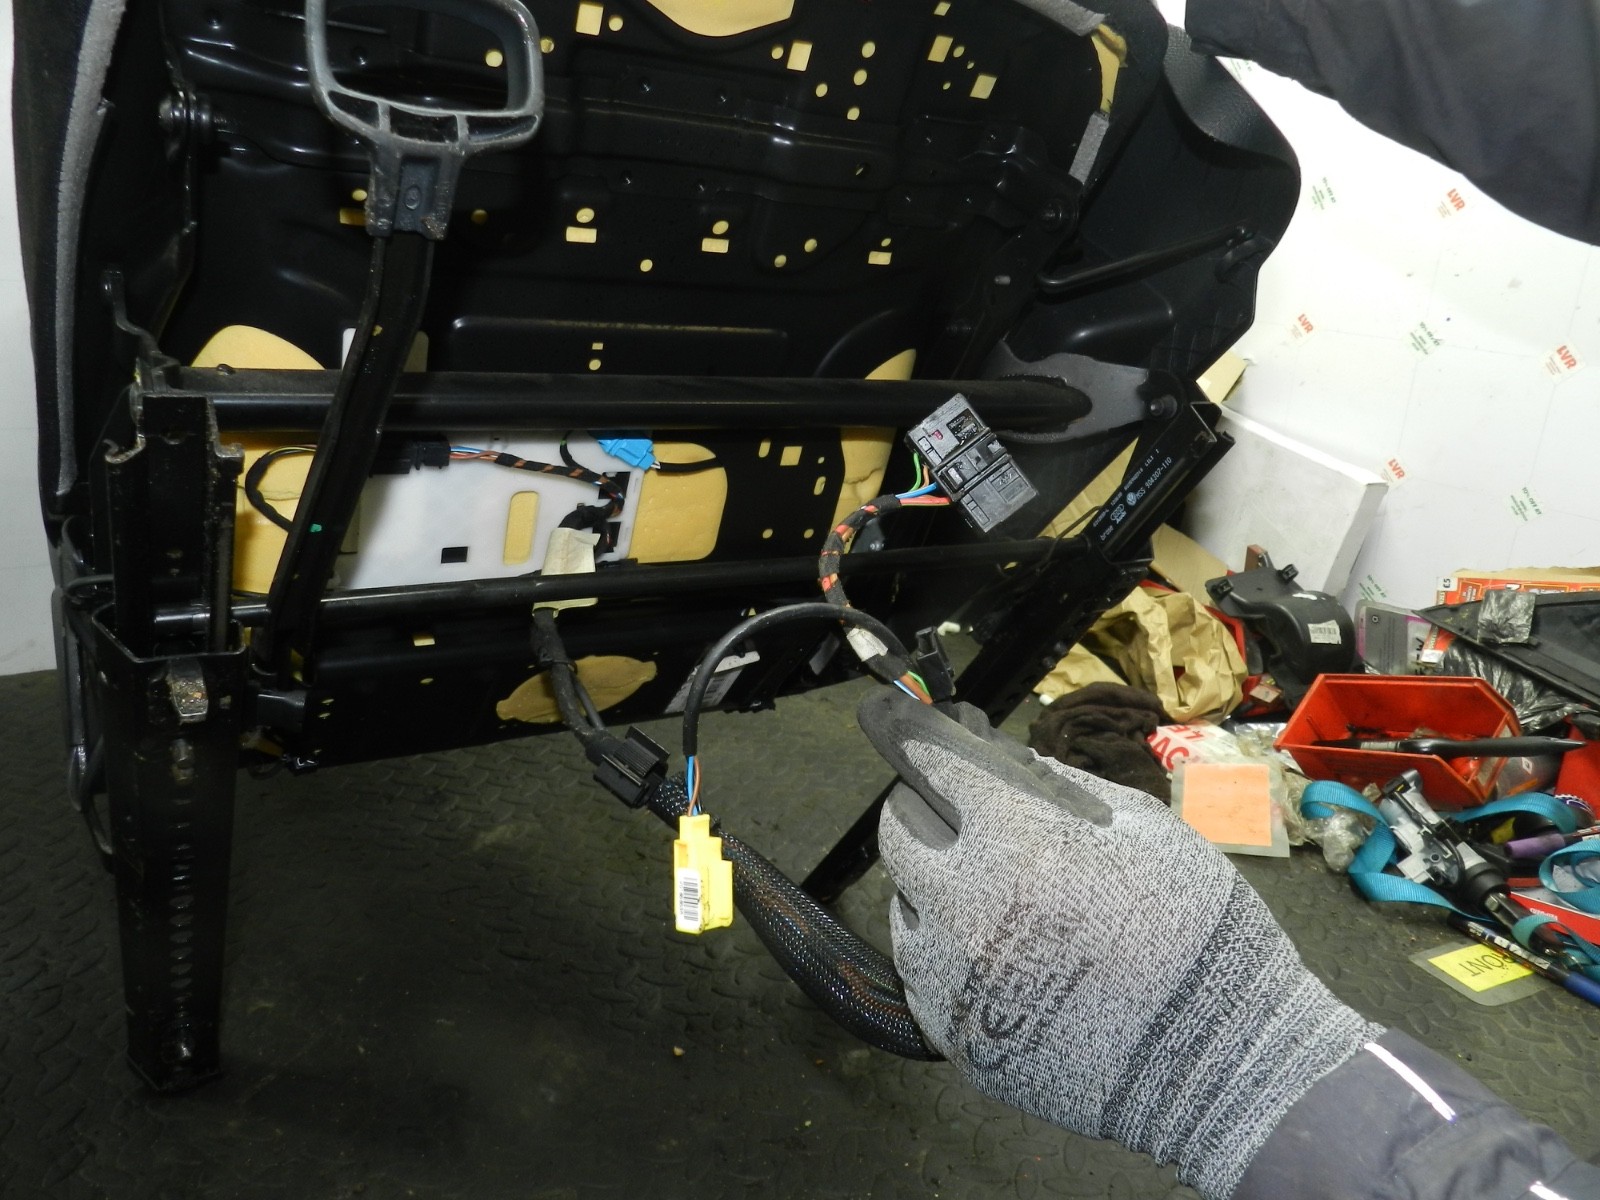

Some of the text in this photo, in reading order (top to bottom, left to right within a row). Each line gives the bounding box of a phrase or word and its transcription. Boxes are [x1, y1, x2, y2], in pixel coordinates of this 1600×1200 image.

[1447, 188, 1465, 211] LVR
[1298, 313, 1314, 334] LVR
[1556, 345, 1577, 370] LVR
[1387, 458, 1405, 480] LVR
